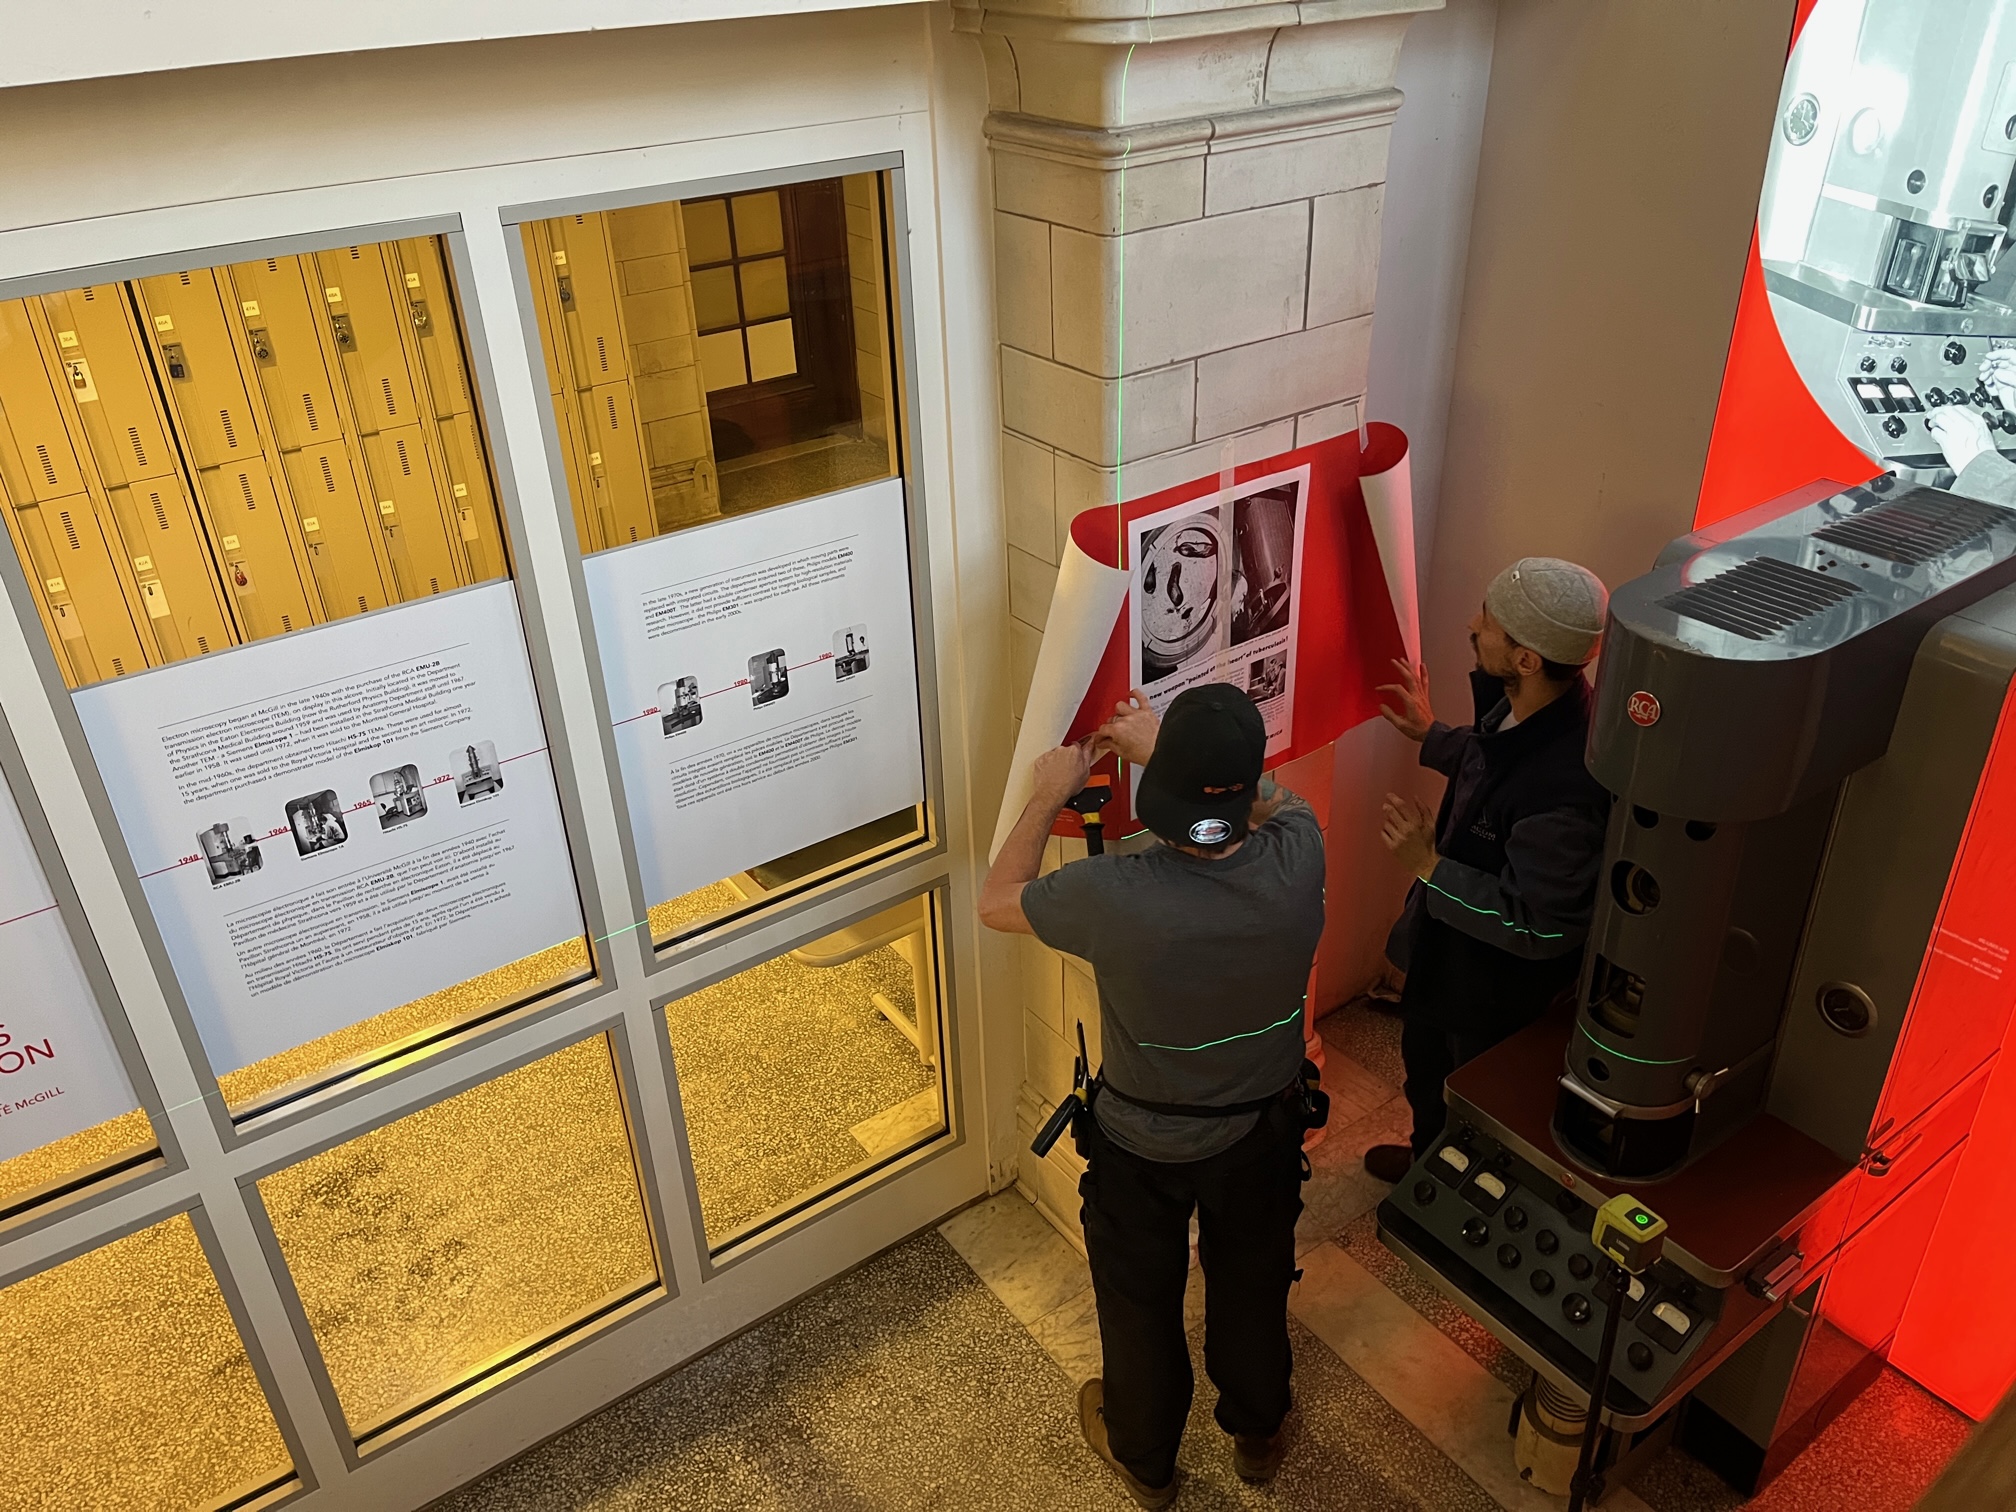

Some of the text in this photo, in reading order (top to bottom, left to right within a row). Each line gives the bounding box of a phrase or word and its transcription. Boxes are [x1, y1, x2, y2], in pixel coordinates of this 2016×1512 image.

[161, 731, 189, 742] Electron
[190, 720, 228, 734] microscopy
[227, 714, 249, 723] began
[257, 705, 279, 715] McGill
[311, 691, 330, 700] 1940s
[356, 677, 382, 689] purchase
[415, 660, 440, 671] EMU-2B
[1149, 691, 1162, 700] new
[1164, 681, 1185, 694] weapon
[164, 735, 204, 750] transmission
[205, 727, 232, 738] electron
[233, 717, 270, 730] microscope
[270, 710, 291, 721] (TEM),
[301, 702, 324, 711] display
[365, 683, 386, 693] Initially
[386, 676, 409, 687] located
[426, 662, 460, 676] Department
[174, 744, 199, 755] Physics
[219, 733, 239, 742] Eaton
[239, 723, 274, 736] Electronics
[274, 716, 301, 726] Building
[301, 711, 317, 720] (now
[328, 697, 361, 711] Rutherford
[361, 693, 383, 702] Physics
[428, 673, 448, 683] moved
[1628, 696, 1658, 720] RCA
[181, 747, 217, 761] Strathcona
[217, 739, 243, 750] Medical
[244, 732, 271, 743] Building
[271, 724, 294, 735] around
[295, 719, 311, 728] 1959
[337, 708, 352, 716] used
[361, 699, 388, 709] Anatomy
[388, 688, 423, 702] Department
[246, 755, 283, 770] department
[284, 746, 312, 758] obtained
[325, 736, 346, 746] Hitachi
[347, 730, 366, 740] HS-7S
[386, 720, 403, 728] These
[419, 710, 433, 719] used
[443, 702, 461, 712] almost
[433, 774, 450, 784] 1972
[353, 799, 371, 809] 1965
[268, 825, 288, 836] 1964
[177, 853, 199, 864] 1948
[15, 1087, 64, 1110] McGILL
